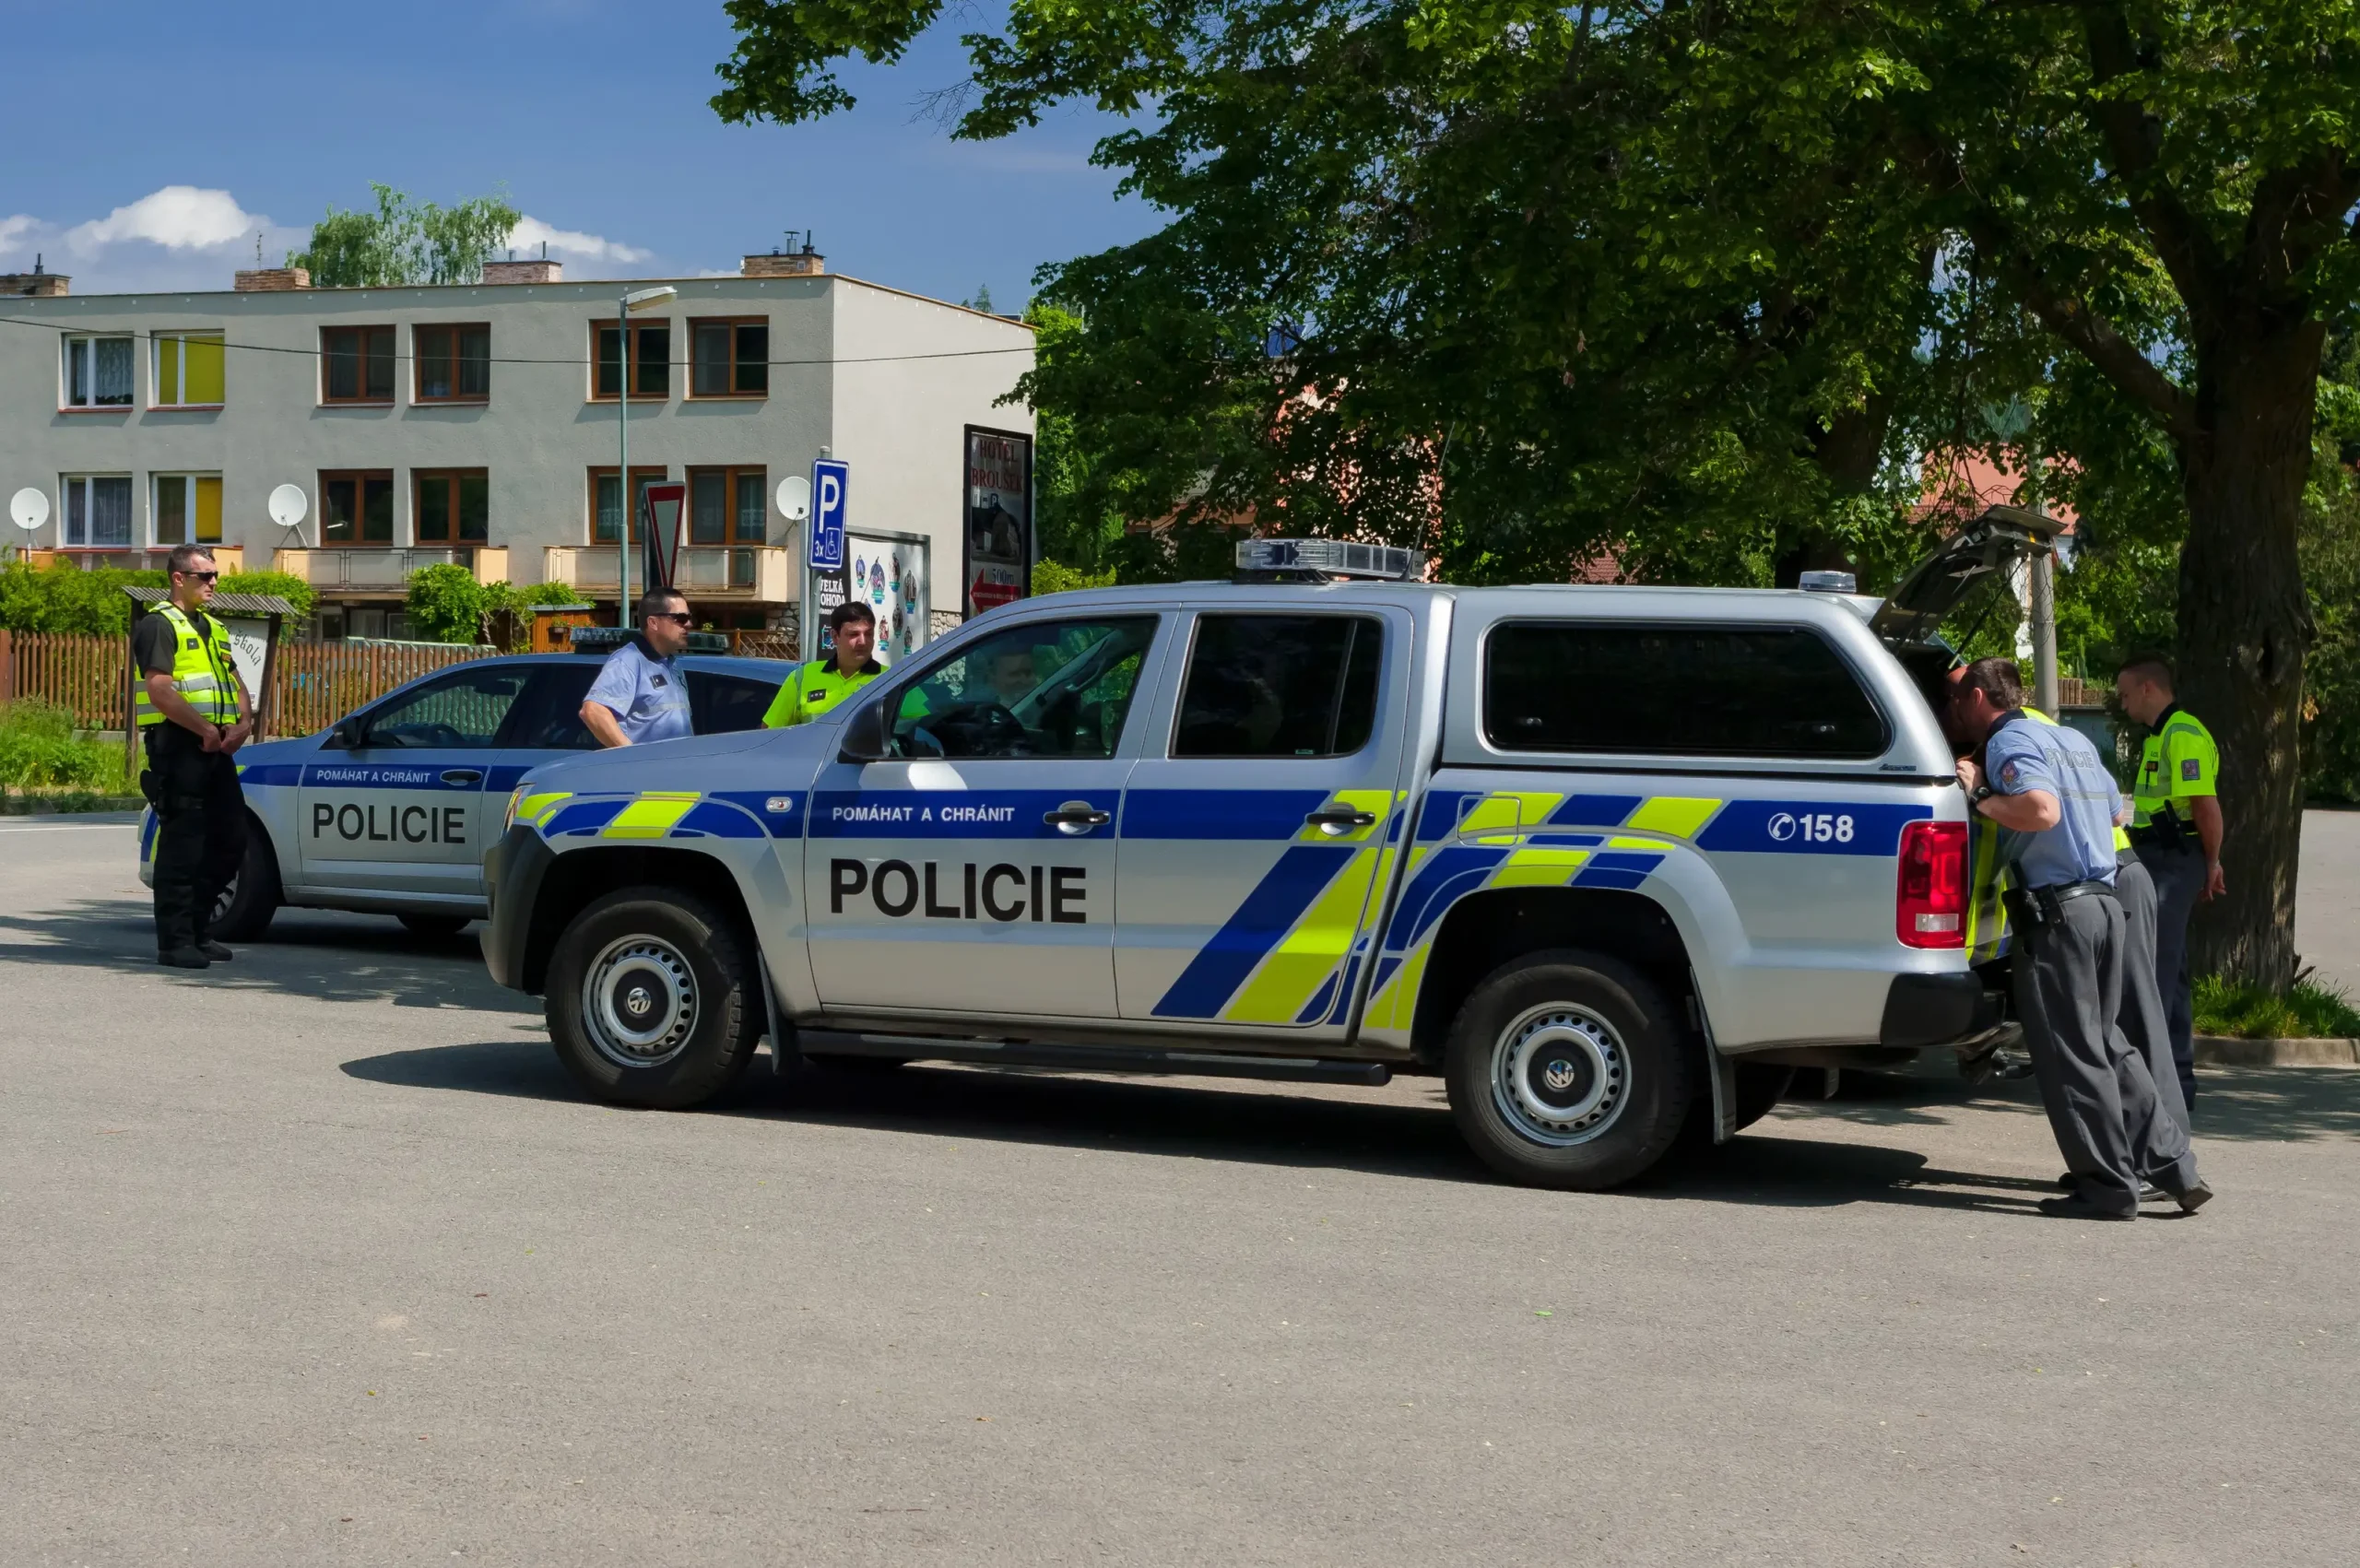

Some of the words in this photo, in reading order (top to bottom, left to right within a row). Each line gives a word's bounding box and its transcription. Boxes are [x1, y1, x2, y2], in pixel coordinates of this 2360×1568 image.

[979, 439, 1018, 463] HOTEL
[819, 475, 840, 534] P
[814, 540, 824, 557] 3x
[820, 593, 846, 607] OHODA
[316, 769, 369, 782] POMÁHAT
[371, 771, 379, 782] A
[382, 770, 431, 784] CHRÁNIT
[313, 803, 466, 844] POLICIE
[832, 804, 914, 821] POMÁHAT
[921, 807, 933, 821] A
[940, 804, 1016, 821] CHRÁNIT
[1799, 814, 1855, 843] 158
[831, 857, 1087, 924] POLICIE
